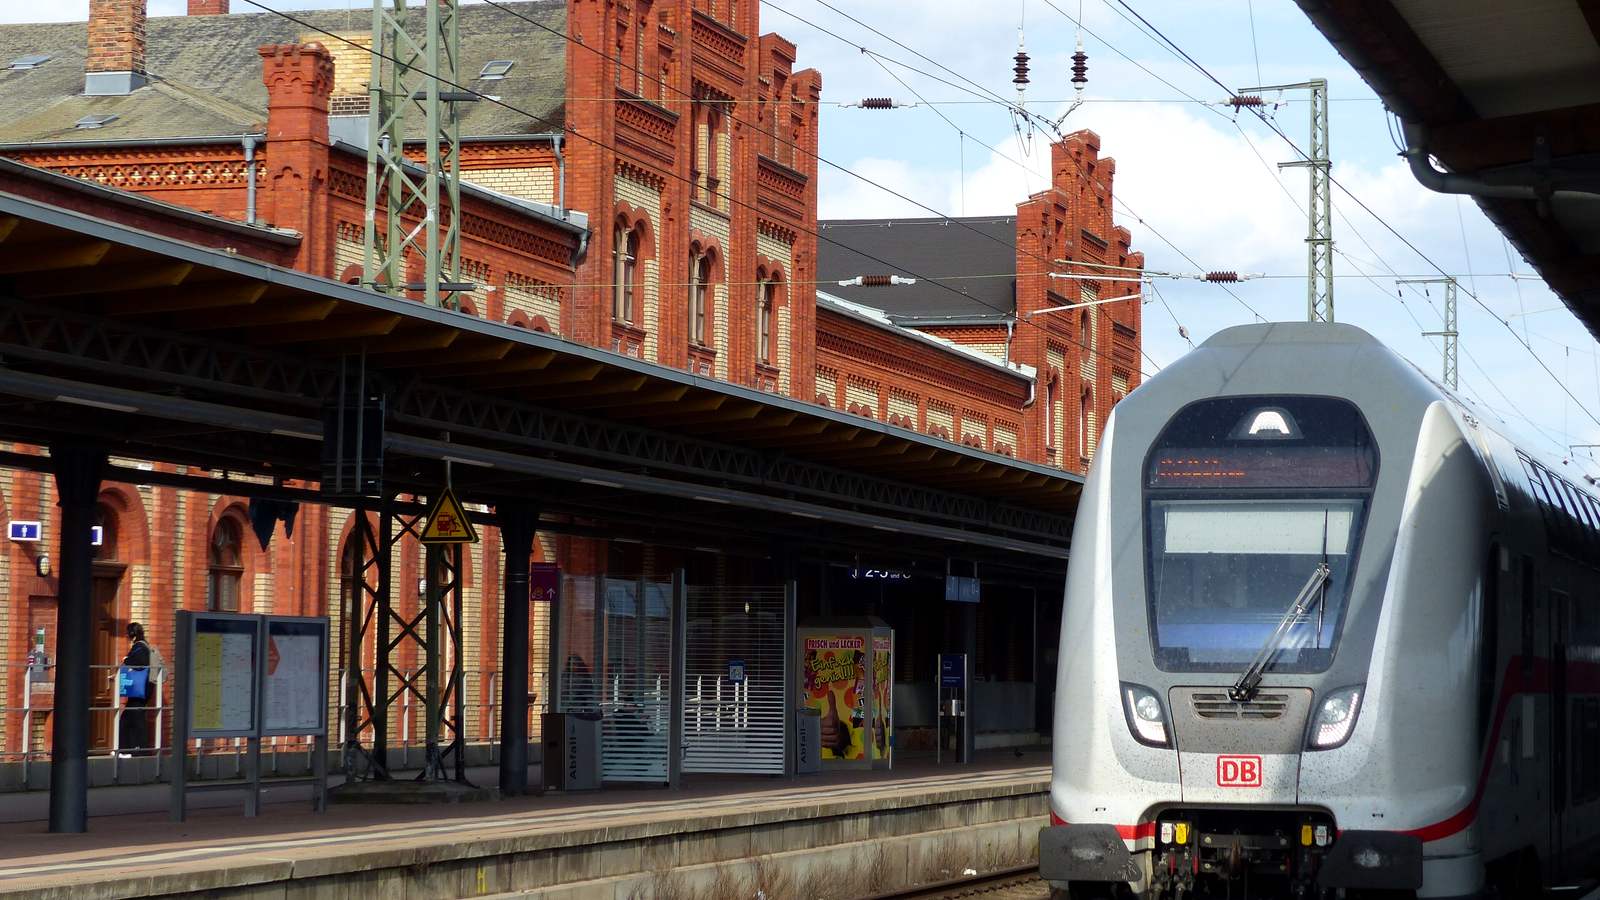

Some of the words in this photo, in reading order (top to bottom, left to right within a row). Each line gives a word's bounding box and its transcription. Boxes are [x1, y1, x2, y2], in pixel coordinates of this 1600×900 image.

[808, 639, 828, 649] FRISCH
[828, 640, 840, 649] und
[840, 639, 861, 649] LECKER
[811, 655, 855, 673] Einfach
[569, 736, 577, 780] Abfall
[1222, 760, 1257, 782] DB
